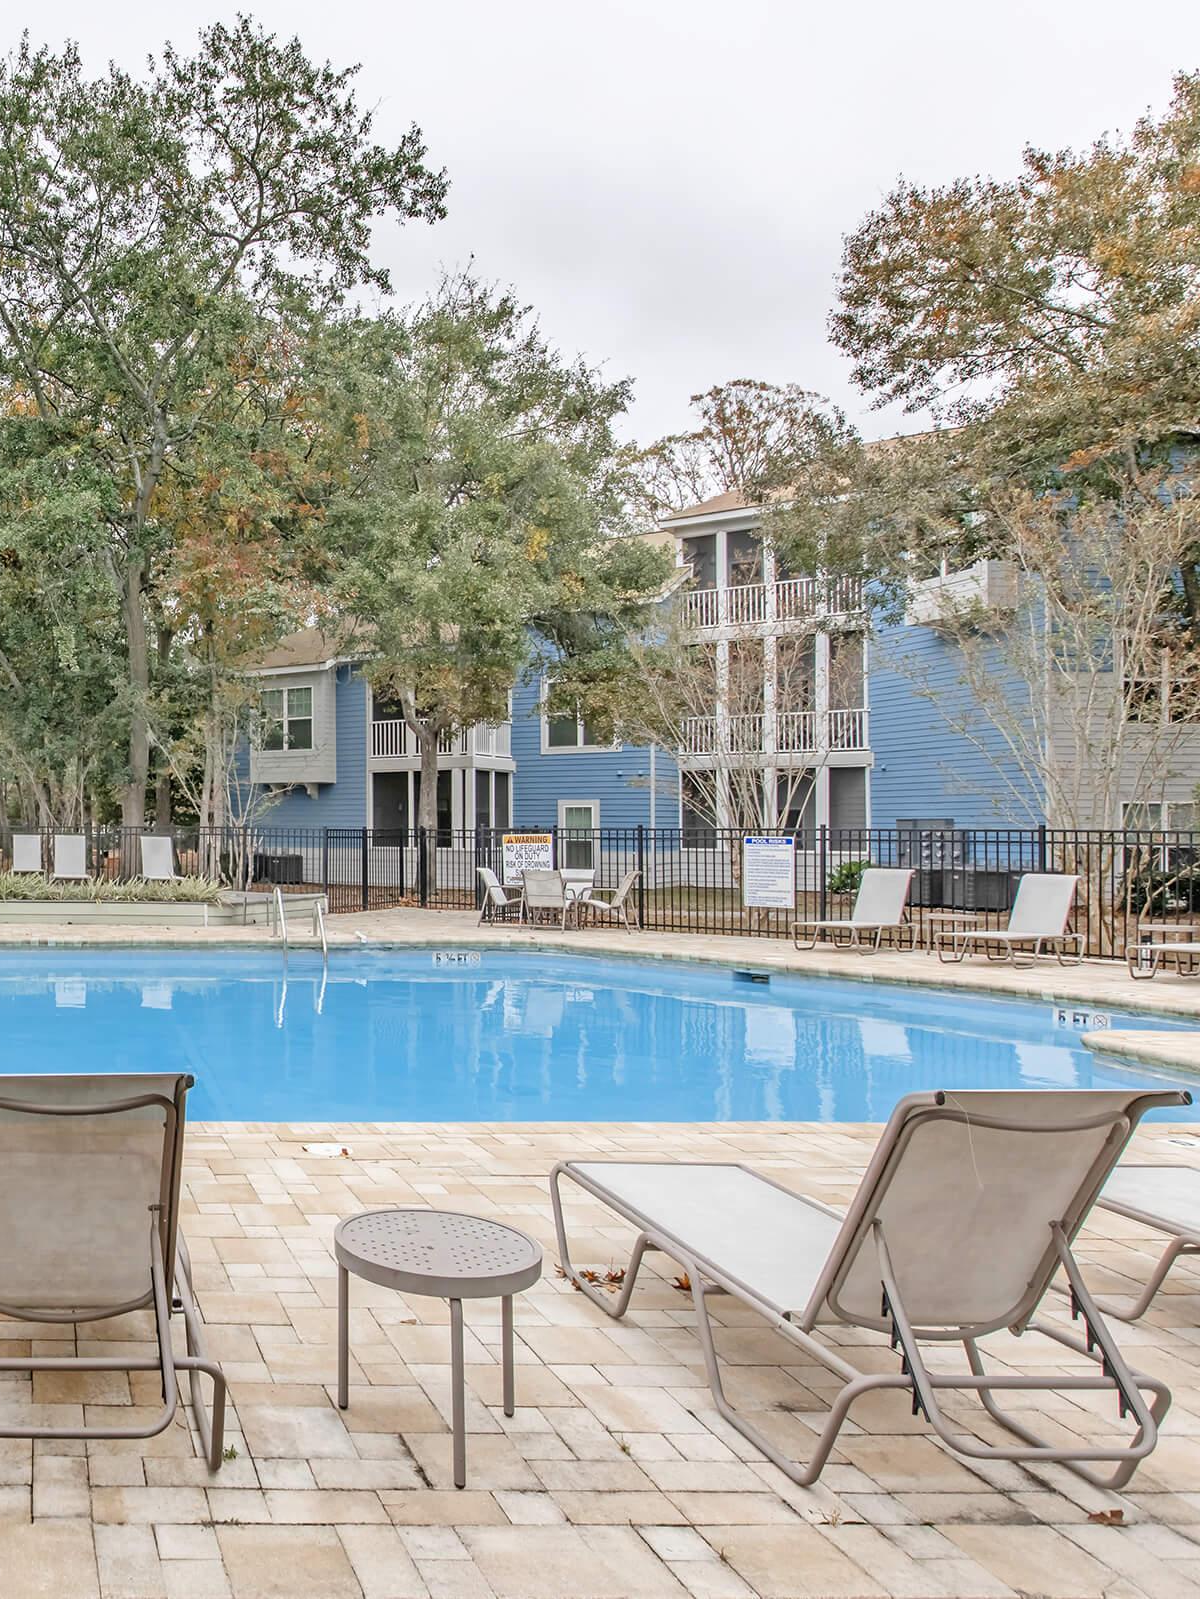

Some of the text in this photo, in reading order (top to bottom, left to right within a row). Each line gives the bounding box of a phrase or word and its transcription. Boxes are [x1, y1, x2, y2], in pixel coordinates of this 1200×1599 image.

[514, 835, 548, 844] WARNING
[505, 845, 550, 853] NO LIFEGUARD
[514, 852, 541, 860] ON DUTY
[505, 861, 550, 869] RISK OF DROWNING
[1072, 1011, 1090, 1025] FT
